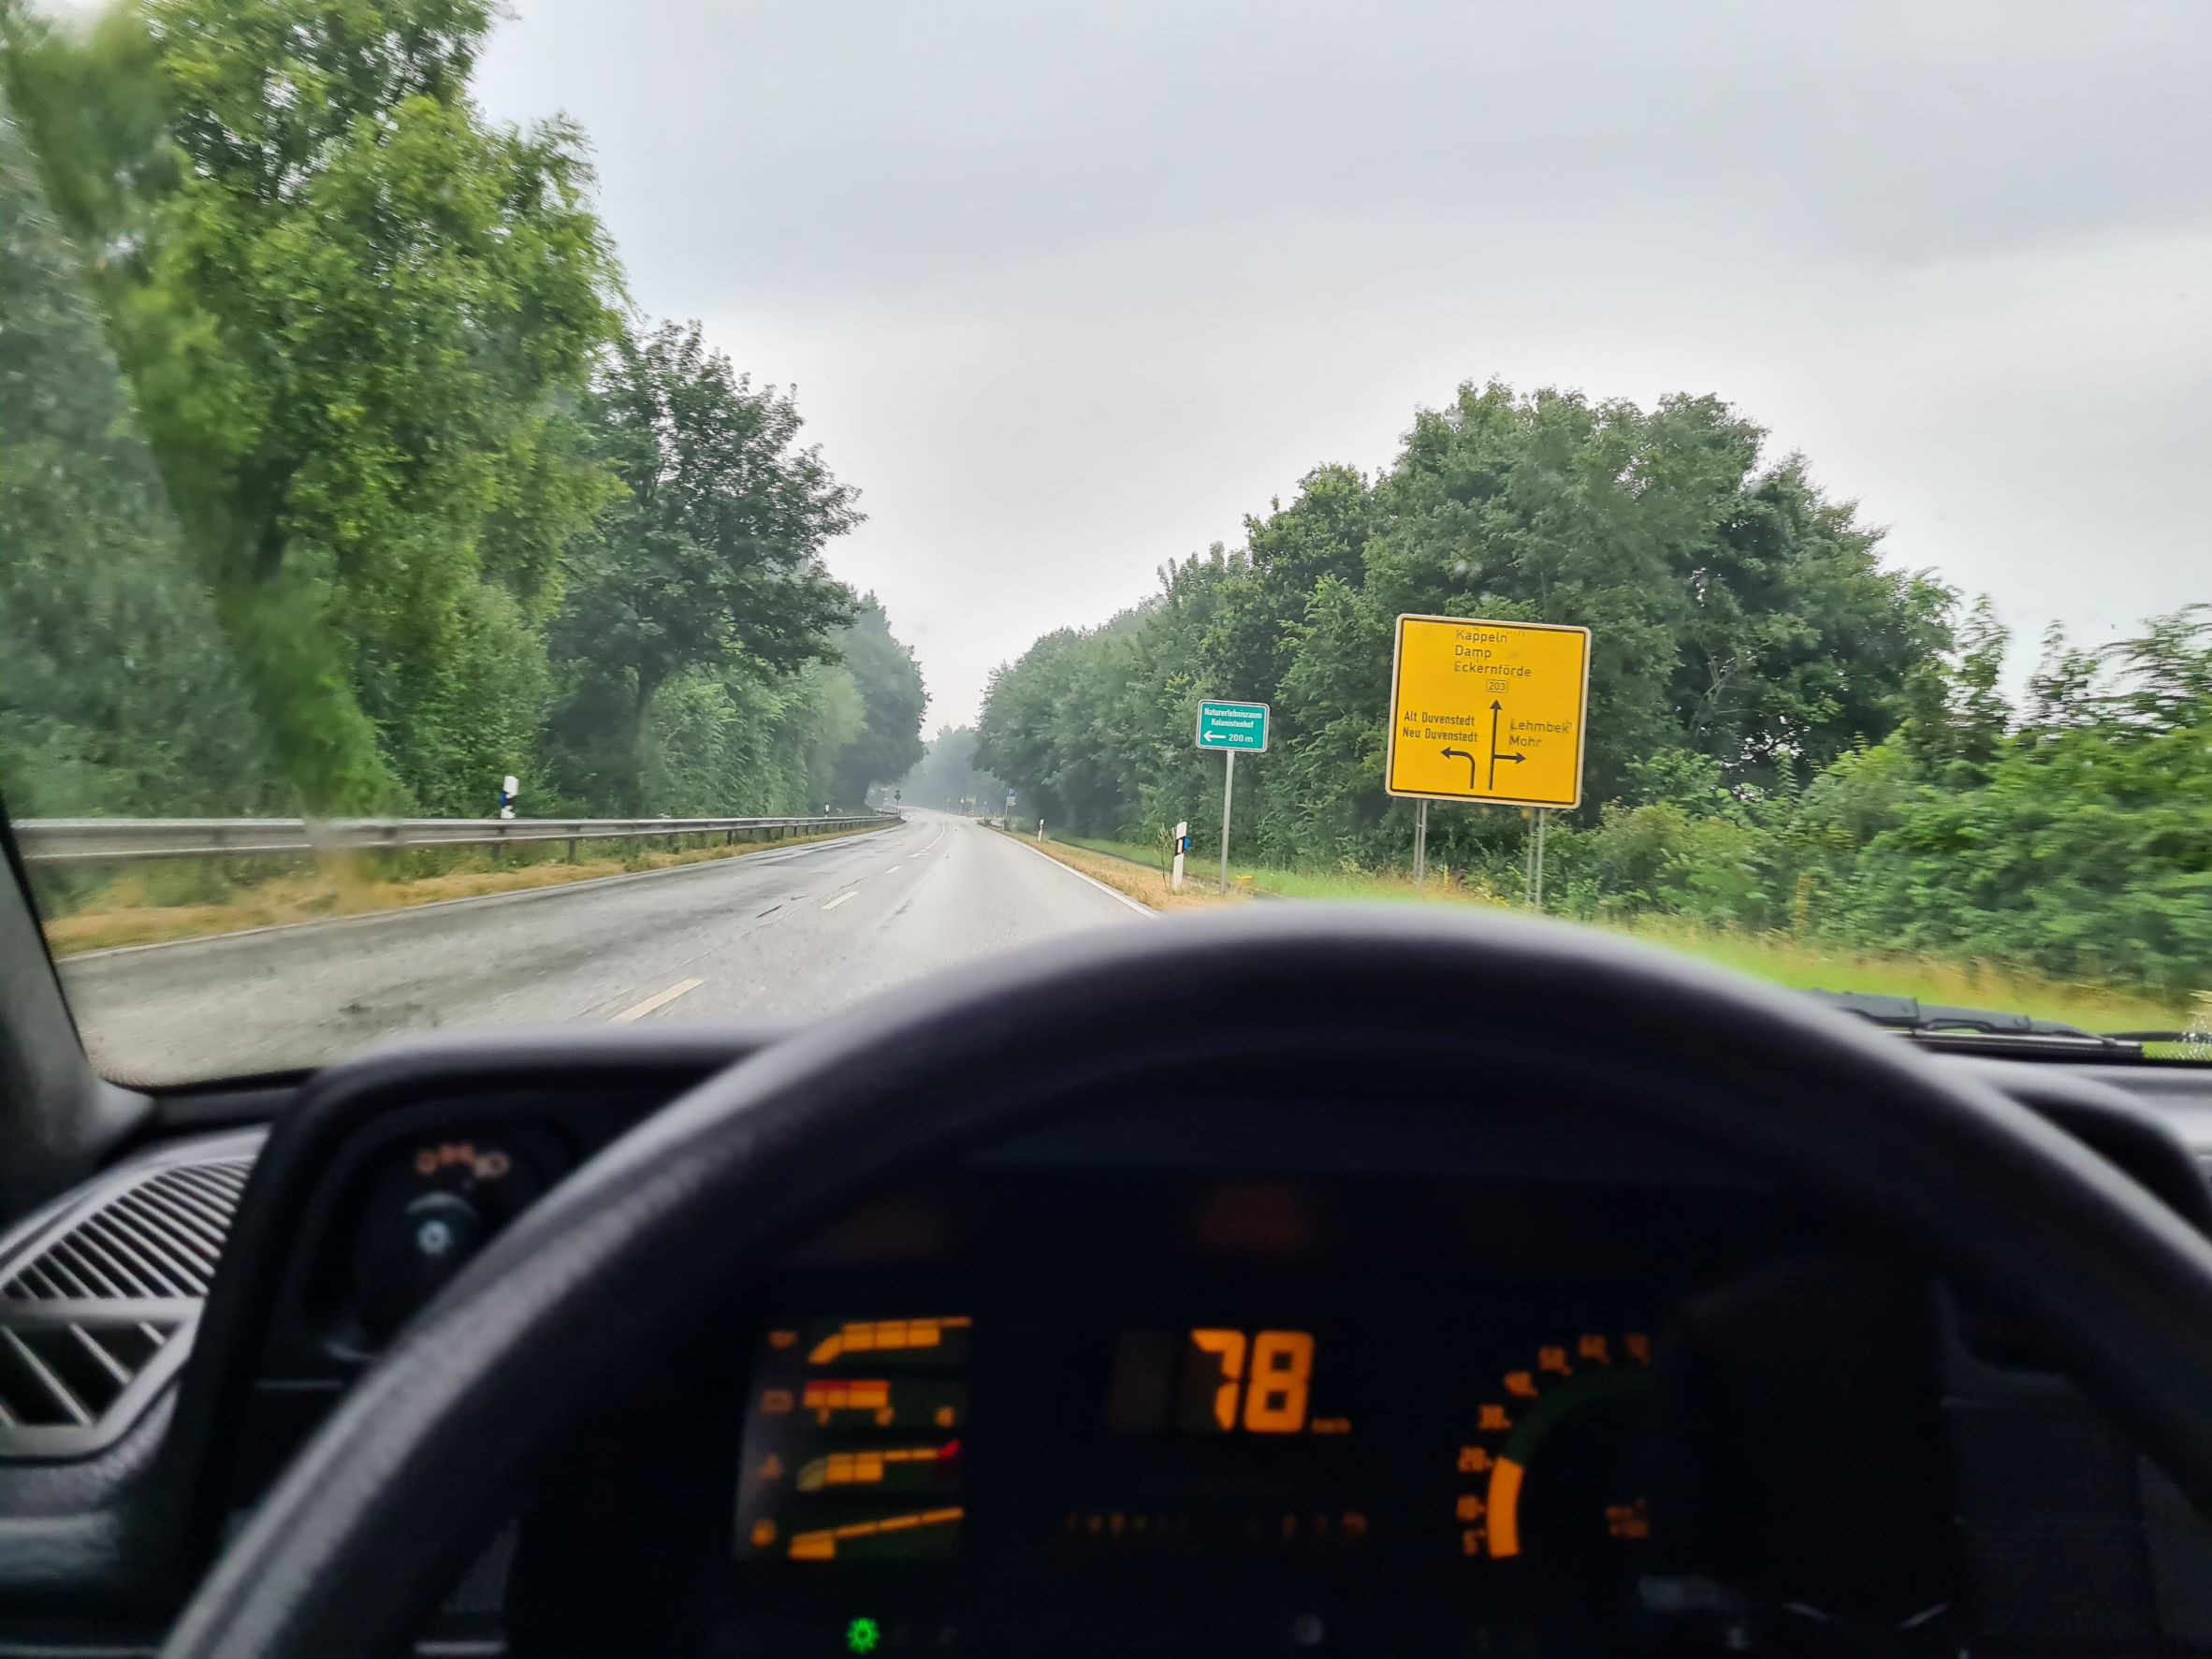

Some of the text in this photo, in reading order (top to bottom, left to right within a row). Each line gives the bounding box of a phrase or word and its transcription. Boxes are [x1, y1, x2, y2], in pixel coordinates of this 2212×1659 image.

[1455, 629, 1507, 644] Kappeln
[1455, 645, 1492, 659] Damp
[1454, 661, 1532, 677] Eckernförde
[1489, 681, 1506, 691] 203
[1404, 710, 1476, 726] Alt Duvenstedt
[1510, 719, 1570, 734] Lehmbek
[1228, 734, 1244, 742] 200
[1402, 726, 1478, 743] Neu Duvenstedt
[1509, 735, 1542, 748] Mohr
[1189, 1326, 1317, 1434] 78
